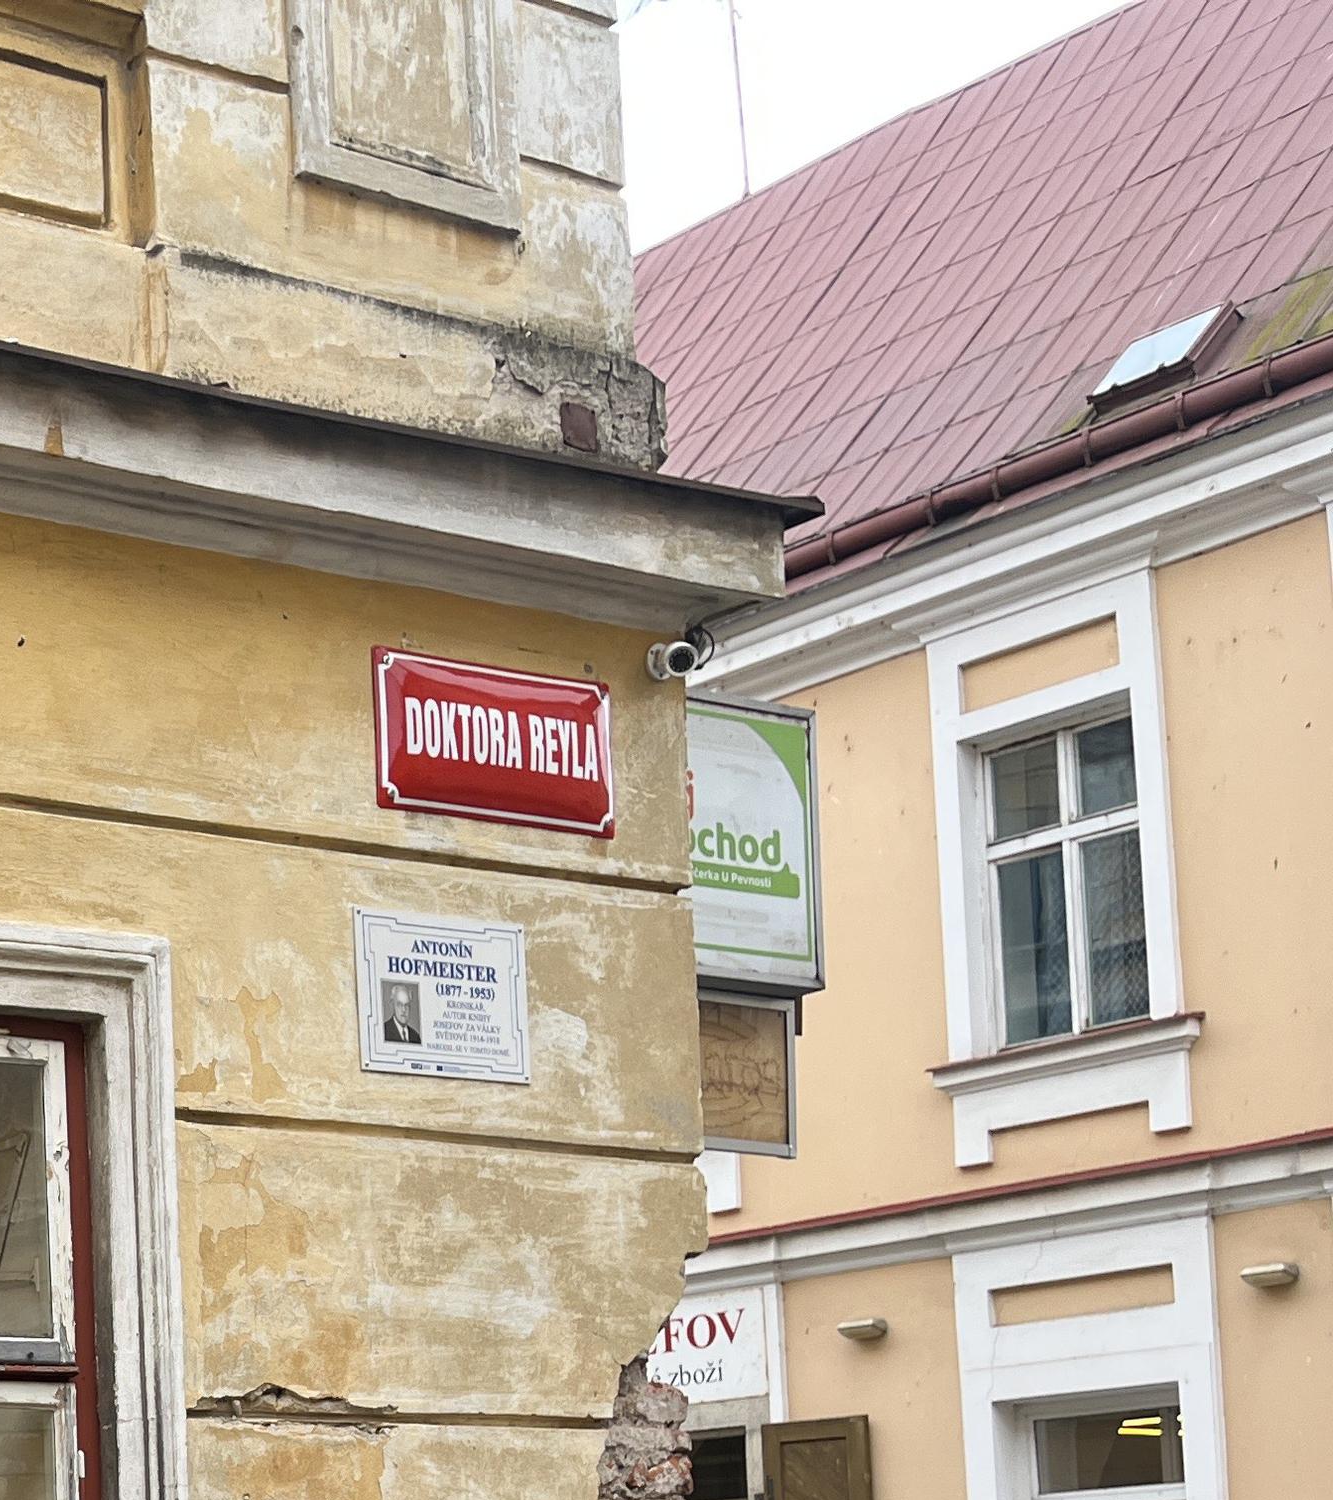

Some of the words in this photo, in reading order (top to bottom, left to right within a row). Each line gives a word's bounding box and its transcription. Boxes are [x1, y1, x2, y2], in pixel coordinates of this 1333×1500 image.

[404, 697, 523, 770] DOKTORA
[527, 714, 599, 783] REYLA
[693, 868, 720, 881] čerka
[721, 872, 729, 881] U
[731, 872, 772, 888] Pevnosti
[411, 939, 473, 959] ANTONÍN
[387, 956, 498, 983] HOFMEISTER
[442, 1011, 466, 1020] AUTOR
[468, 1014, 492, 1023] KNIHY
[649, 1308, 745, 1355] FOV
[668, 1359, 723, 1387] zboží
